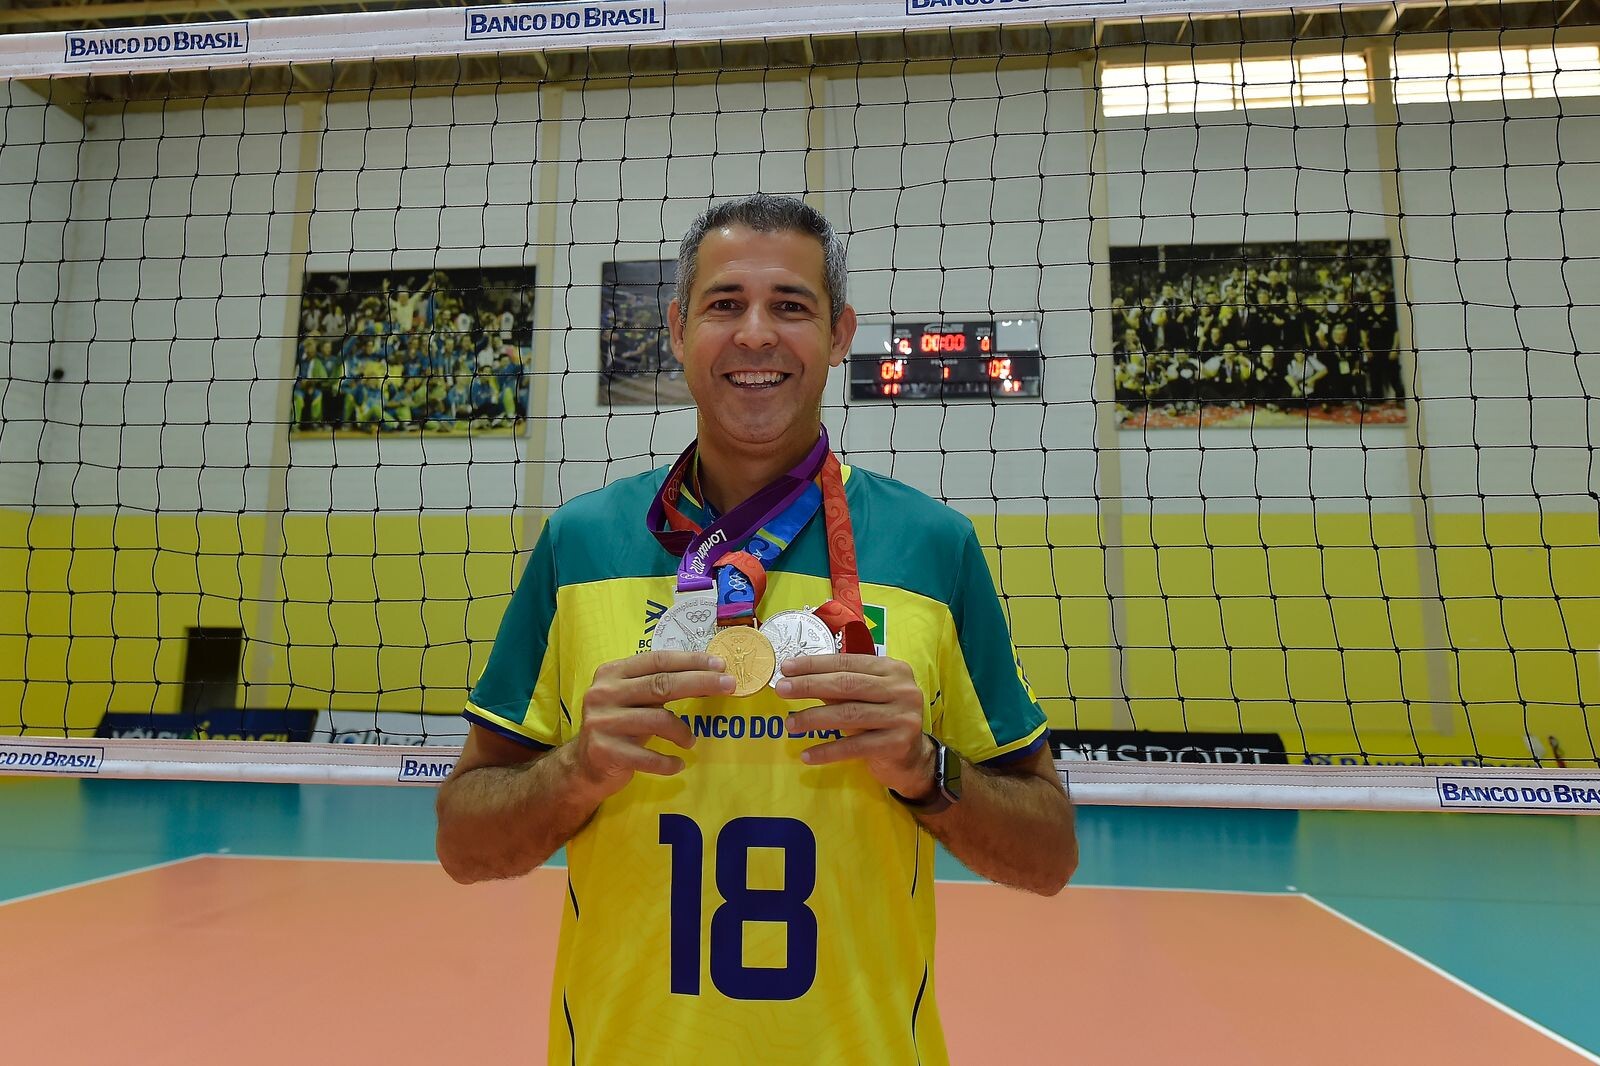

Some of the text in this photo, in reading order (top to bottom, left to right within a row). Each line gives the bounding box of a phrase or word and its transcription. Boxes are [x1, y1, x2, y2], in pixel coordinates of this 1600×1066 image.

[471, 7, 660, 34] BANCO DO BRASIL
[70, 31, 243, 57] BANCO DO BRASIL
[750, 715, 784, 739] DO
[19, 752, 42, 766] DO
[42, 751, 97, 768] BRASIL
[403, 759, 455, 777] BANC
[1442, 782, 1600, 804] BANCO DO BRA
[659, 813, 818, 1001] 18
